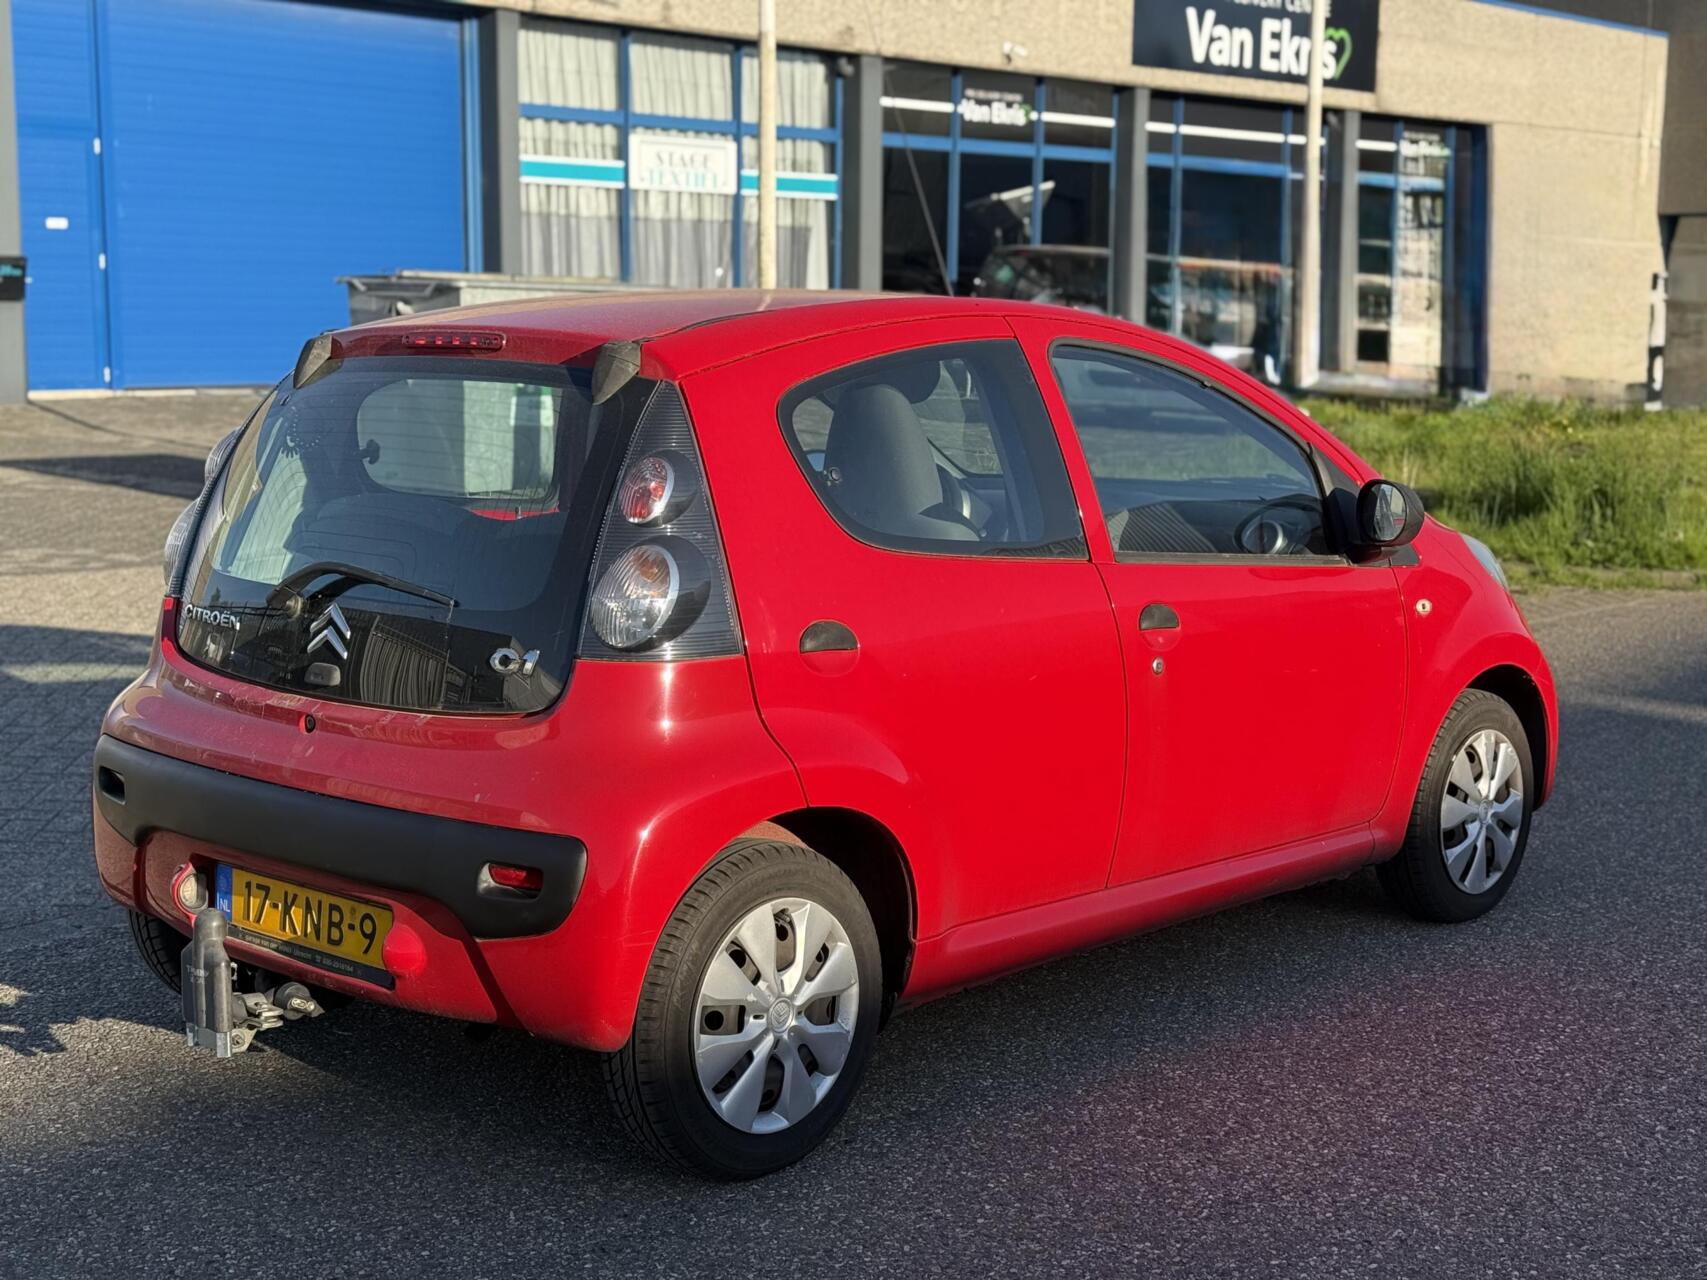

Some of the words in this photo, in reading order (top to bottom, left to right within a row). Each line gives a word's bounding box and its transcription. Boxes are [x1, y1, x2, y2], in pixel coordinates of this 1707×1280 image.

[1185, 6, 1253, 69] Van
[1260, 17, 1338, 80] Ekrs
[185, 604, 240, 630] CITROËN
[489, 648, 540, 676] C1
[243, 880, 377, 955] 17-KNB-9
